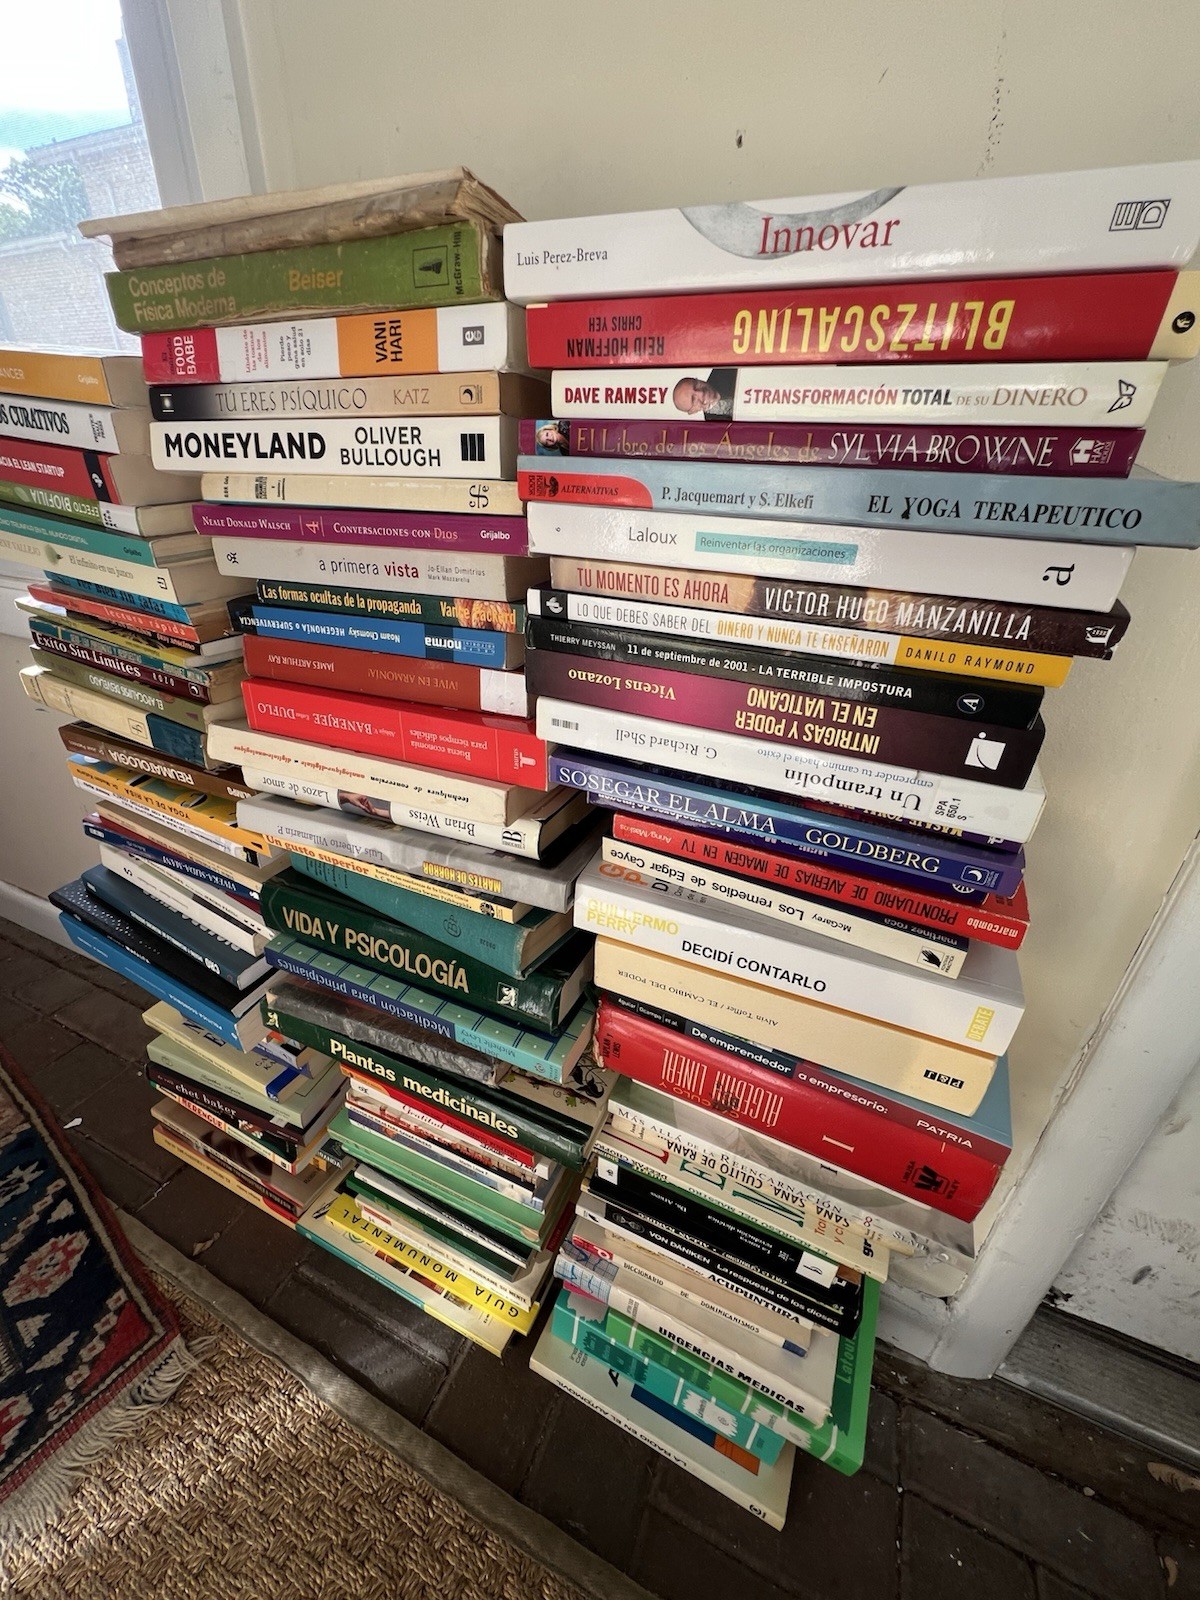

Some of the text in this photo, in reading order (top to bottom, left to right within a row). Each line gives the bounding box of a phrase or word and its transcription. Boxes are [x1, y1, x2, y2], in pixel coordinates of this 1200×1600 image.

[757, 215, 901, 256] Innovar
[517, 248, 608, 266] Luis Perez-Breva
[129, 268, 224, 296] Conceptos de
[288, 268, 343, 291] Beiser
[589, 316, 641, 332] CHRIS YEH
[733, 300, 1015, 354] BLITZSCALING
[376, 322, 387, 363] VANI
[391, 319, 402, 361] HARI
[567, 336, 664, 357] REID HOFFMAN
[175, 337, 184, 376] FOOD
[185, 336, 196, 375] BABE
[216, 386, 429, 413] TÚ ERES PSÍQUICO KATZ
[565, 387, 668, 404] DAVE RAMSEY
[9, 405, 69, 434] CURATIVOS
[165, 432, 326, 459] MONEYLAND
[355, 427, 422, 445] OLIVER
[21, 461, 37, 472] LEAN
[37, 462, 64, 477] STARTUP
[341, 449, 440, 467] BULLOUGH
[30, 489, 100, 517] EFECTO BIOFILIA
[629, 527, 845, 559] Laloux Reinventar las organizaciones
[69, 555, 76, 564] El
[319, 558, 418, 578] a primera vista
[262, 584, 516, 625] Las formas ocultas de la propaganda Vance Packard
[577, 568, 1032, 640] TU MOMENTO ES AHORA VICTOR HUGO MANZANILLA
[103, 607, 186, 636] lectura rápida
[425, 636, 462, 650] norma
[577, 604, 1035, 675] LO QUE DEBES SABER DEL DINERO Y NUNCA TE ENSEÑARON DANILO RAYMOND
[268, 654, 334, 672] JAMES ARTHUR RAY
[569, 669, 676, 700] Vicens Lozano
[258, 702, 372, 735] BANERJEE DUFLO
[748, 687, 878, 728] EN EL VATICANO
[410, 740, 471, 760] Buena economía
[616, 729, 717, 759] G. Richard Shell
[263, 777, 329, 803] Lazos de amor
[785, 768, 921, 811] Un trampolín
[155, 801, 166, 810] DE
[168, 806, 190, 819] YOGA
[559, 768, 940, 872] SOSEGAR EL ALMA GOLDBERG
[935, 799, 947, 816] SPA
[409, 809, 475, 837] Brian Weiss
[267, 834, 280, 845] Un
[281, 842, 315, 857] gusto
[318, 852, 369, 875] superior
[682, 840, 695, 852] TV
[703, 845, 716, 858] EN
[725, 850, 768, 871] IMAGEN
[423, 860, 501, 893] MARTES DE HORROR
[774, 864, 788, 878] DE
[795, 870, 846, 892] AVERIAS
[611, 849, 851, 932] McGarey Los remedios de Edgar Cayce
[851, 884, 868, 899] DE
[586, 899, 679, 935] GUILLERMO
[874, 890, 959, 925] PRONTUARIO
[967, 917, 1018, 937] marcombo
[282, 906, 325, 940] VIDA
[326, 921, 339, 944] Y
[345, 927, 470, 994] PSICOLOGÍA
[682, 941, 827, 993] DECIDÍ CONTARLO
[277, 958, 451, 1038] Meditación para principiantes
[330, 1039, 396, 1081] Plantas
[403, 1076, 518, 1139] medicinales
[692, 1027, 973, 1149] De emprendedor a empresario: PATRIA
[202, 1096, 237, 1117] baker
[342, 1208, 459, 1282] MONUMENTAL
[624, 1262, 664, 1286] DICCIONARIO
[701, 1301, 759, 1334] DOMINICANISMOS
[707, 1273, 802, 1324] ACUPUNTURA
[659, 1326, 805, 1413] URGENCIAS MEDICAS
